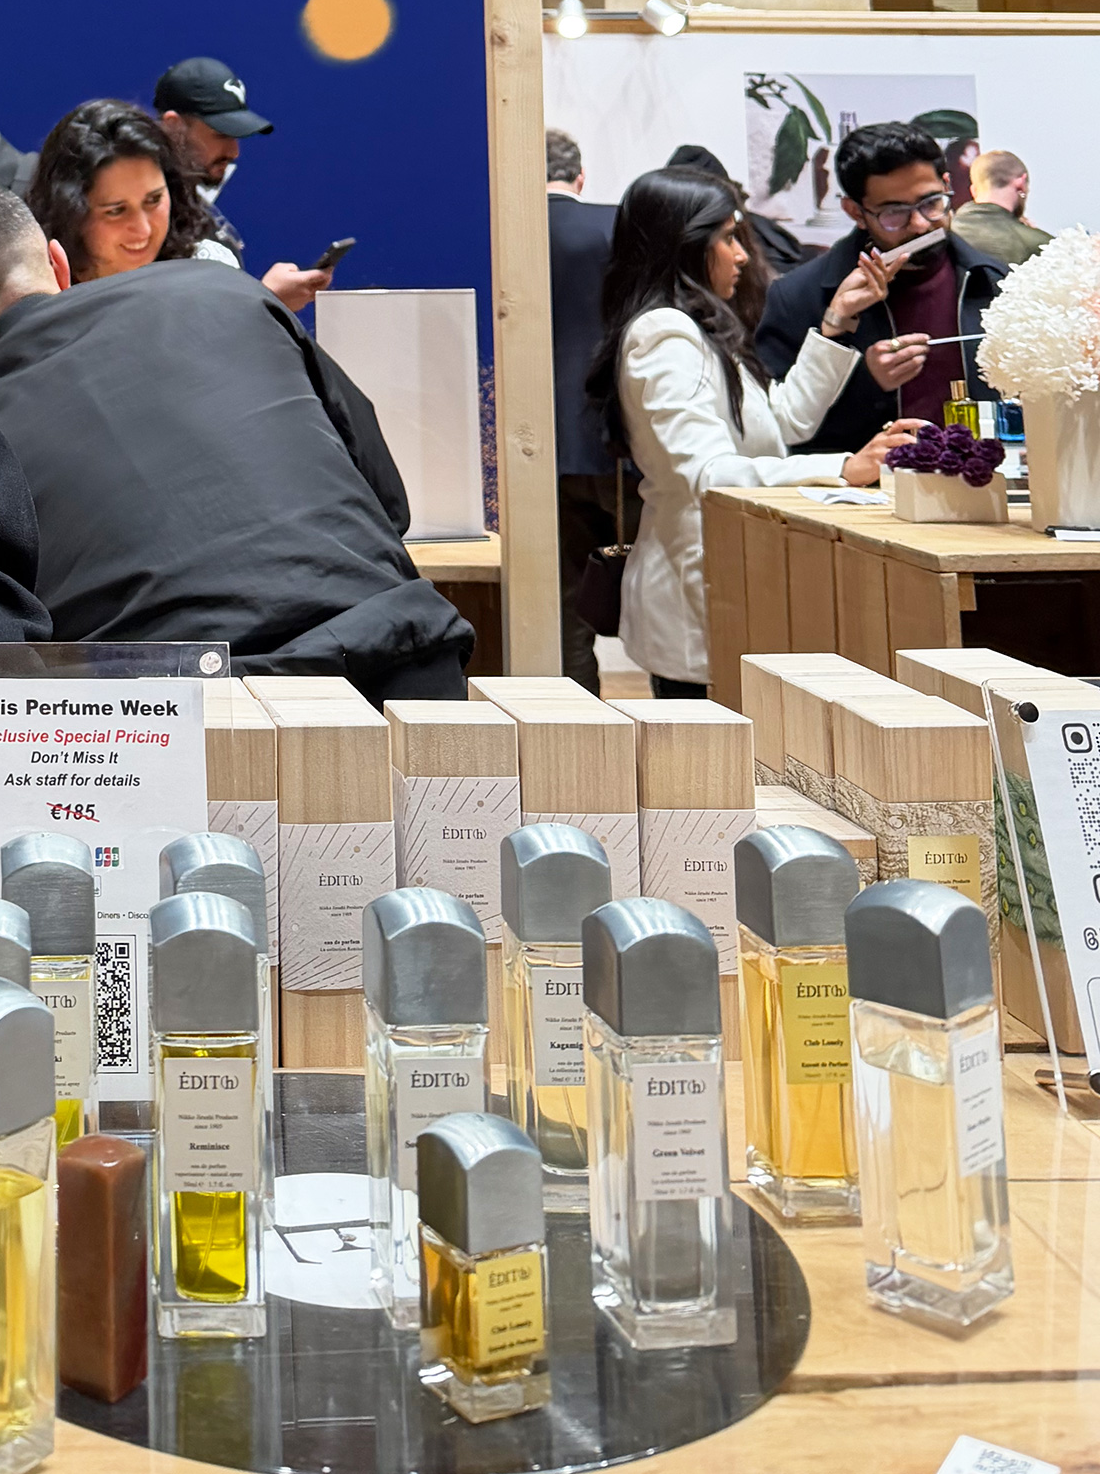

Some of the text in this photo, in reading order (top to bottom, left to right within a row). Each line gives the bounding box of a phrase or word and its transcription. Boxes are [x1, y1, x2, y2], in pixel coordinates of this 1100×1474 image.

[25, 698, 113, 716] Perfume
[120, 699, 179, 716] Week
[53, 729, 111, 747] Special
[114, 729, 170, 748] Pricing
[30, 750, 119, 765] Don't Miss It
[4, 773, 141, 787] Ask staff for details
[49, 803, 97, 821] €185
[97, 911, 149, 919] Diners Disco
[545, 979, 583, 996] ĖDIT
